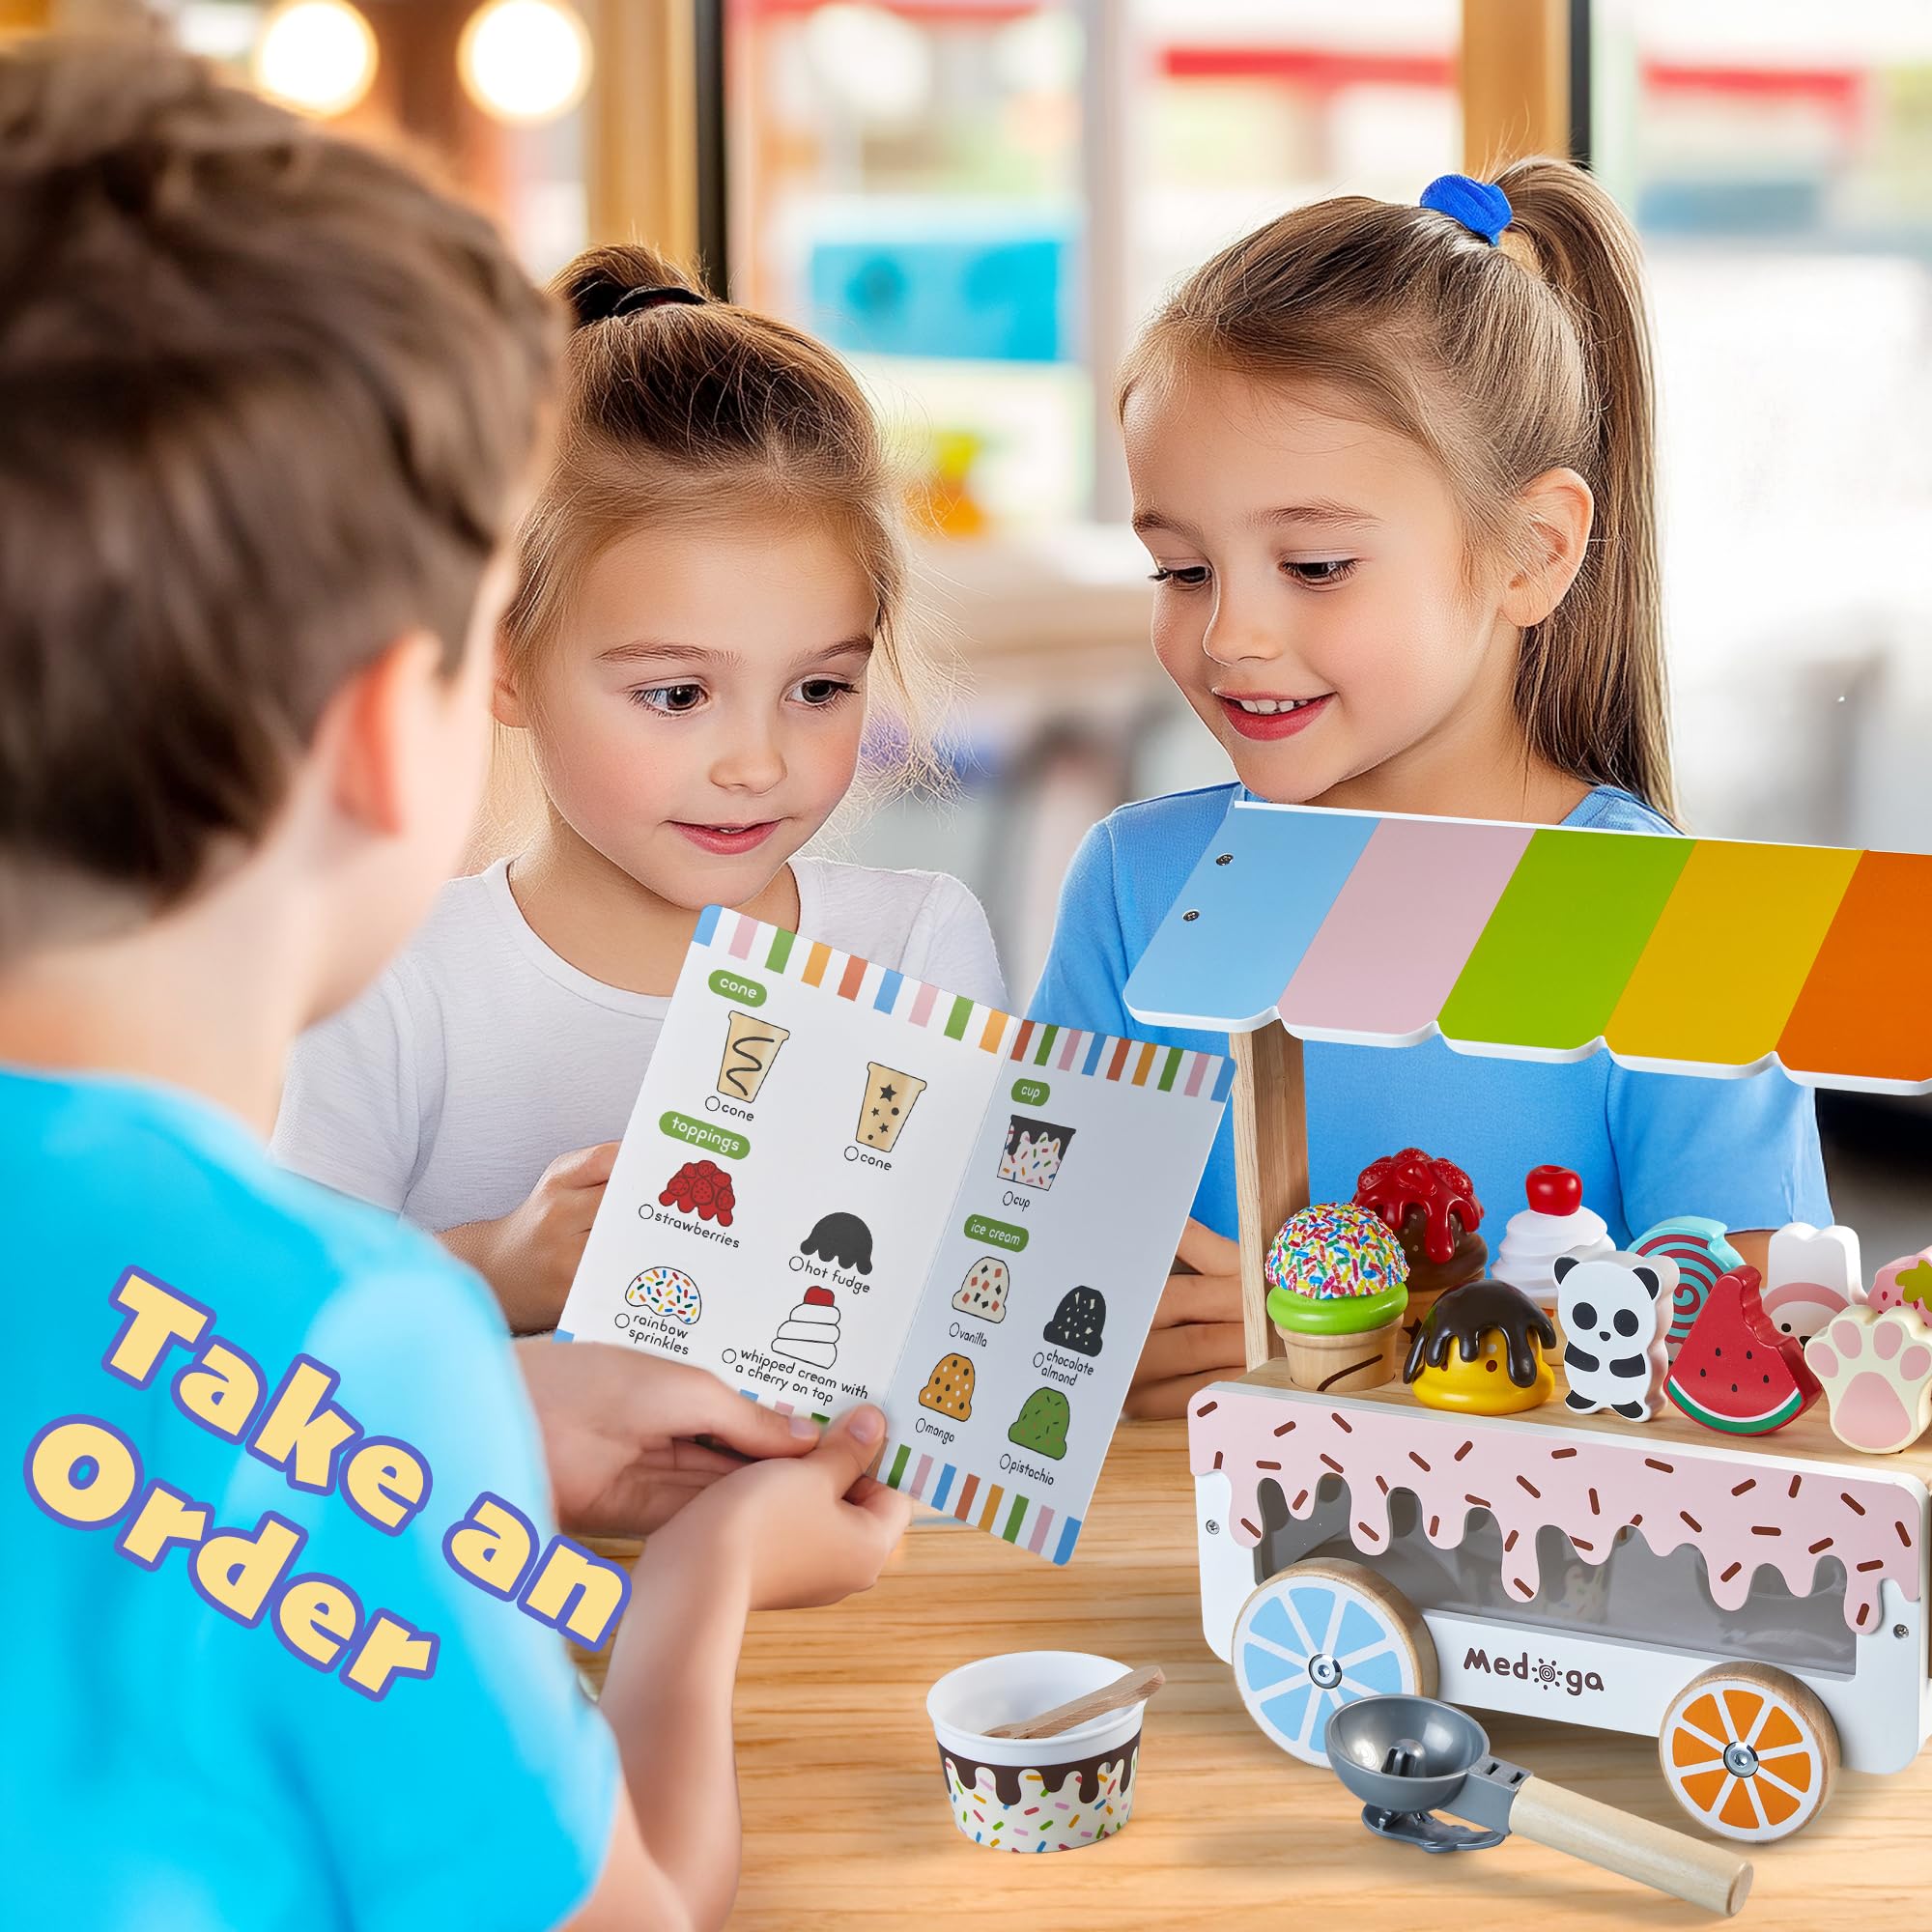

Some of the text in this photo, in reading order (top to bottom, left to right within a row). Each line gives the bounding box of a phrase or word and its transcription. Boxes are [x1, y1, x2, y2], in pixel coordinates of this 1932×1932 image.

[720, 979, 757, 999] cone
[1021, 1084, 1040, 1102] cup
[722, 1103, 754, 1122] cone
[670, 1117, 740, 1152] toppings
[860, 1153, 892, 1172] cone
[1013, 1197, 1031, 1211] cup
[654, 1210, 740, 1249] strawberries
[970, 1219, 1020, 1245] ice cream
[805, 1262, 870, 1294] hot fudge
[633, 1313, 688, 1340] rainbow
[959, 1330, 987, 1348] vanilla
[628, 1327, 689, 1355] sprinkles
[740, 1348, 868, 1400] whipped cream with
[1046, 1350, 1094, 1376] chocolate
[735, 1364, 834, 1405] a cherry on top
[1041, 1367, 1077, 1386] almond
[924, 1424, 955, 1444] mango
[1009, 1459, 1055, 1486] pistachio
